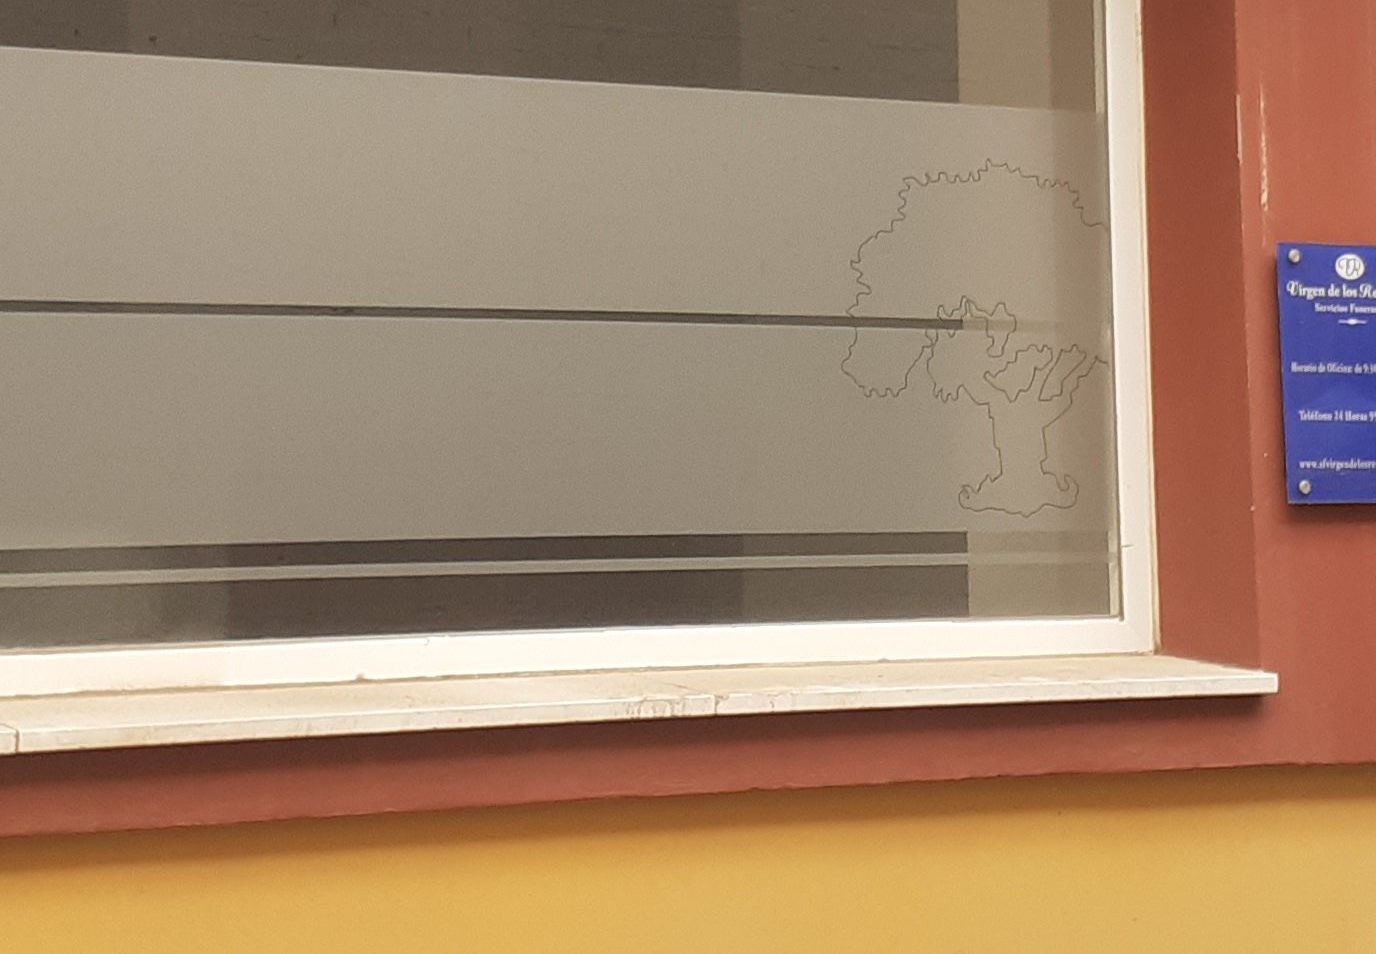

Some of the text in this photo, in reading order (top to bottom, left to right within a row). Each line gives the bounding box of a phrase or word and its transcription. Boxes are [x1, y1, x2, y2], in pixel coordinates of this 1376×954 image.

[1286, 280, 1326, 300] Virgen
[1327, 282, 1341, 298] de
[1342, 283, 1358, 298] los
[1314, 302, 1348, 313] Servicios
